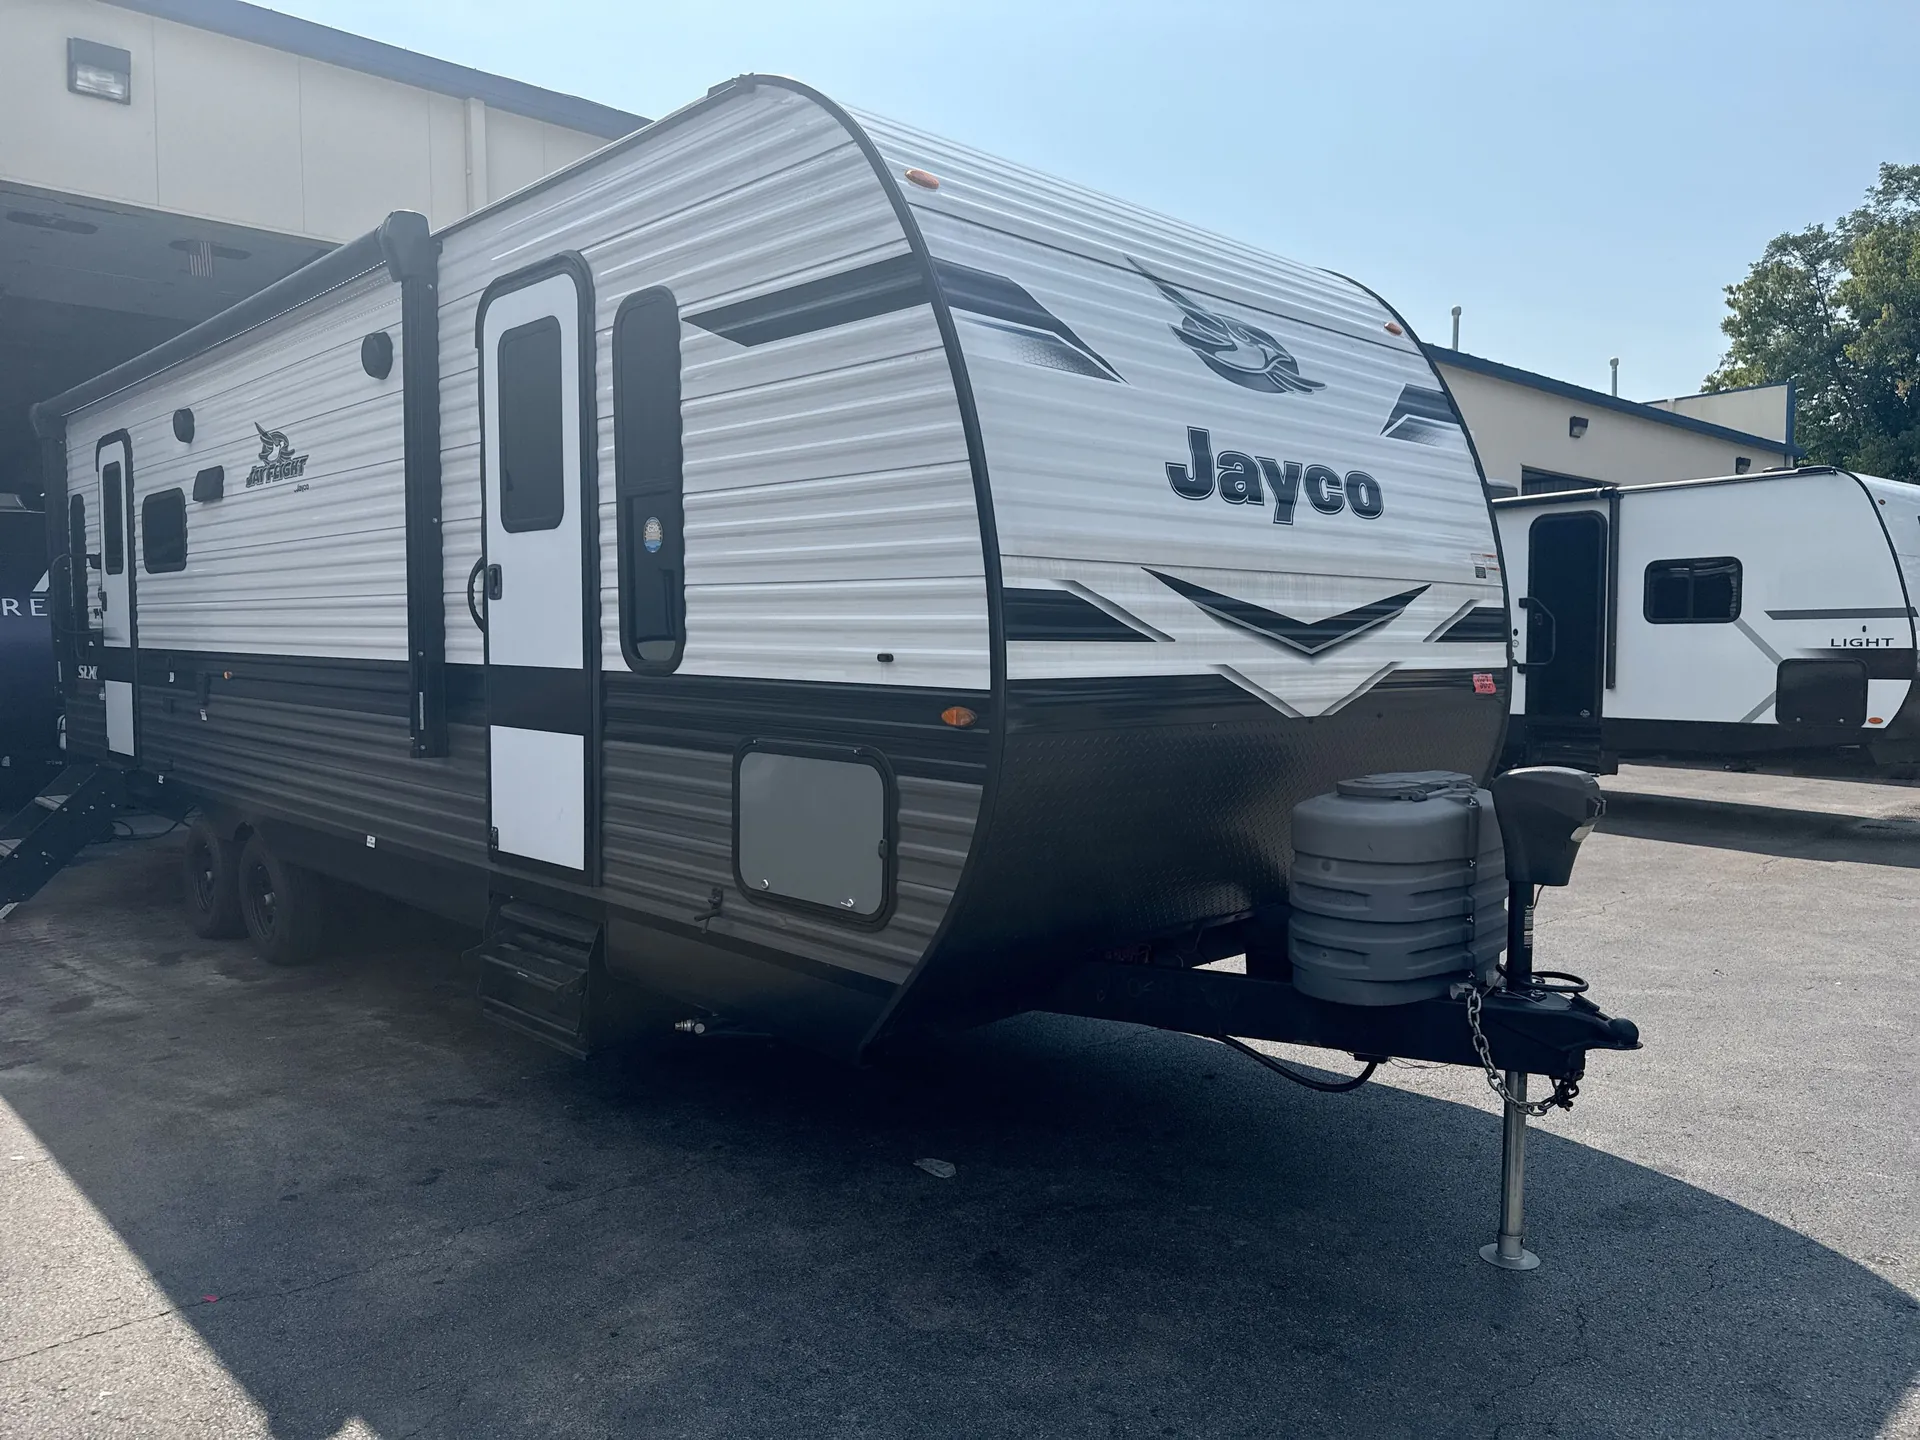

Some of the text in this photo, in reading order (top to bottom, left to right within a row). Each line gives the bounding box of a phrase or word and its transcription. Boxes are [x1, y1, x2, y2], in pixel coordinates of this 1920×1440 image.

[245, 454, 310, 488] JAY FLIGHT
[1165, 425, 1384, 526] Jayco
[1830, 637, 1895, 648] LIGHT
[77, 664, 99, 680] SLX
